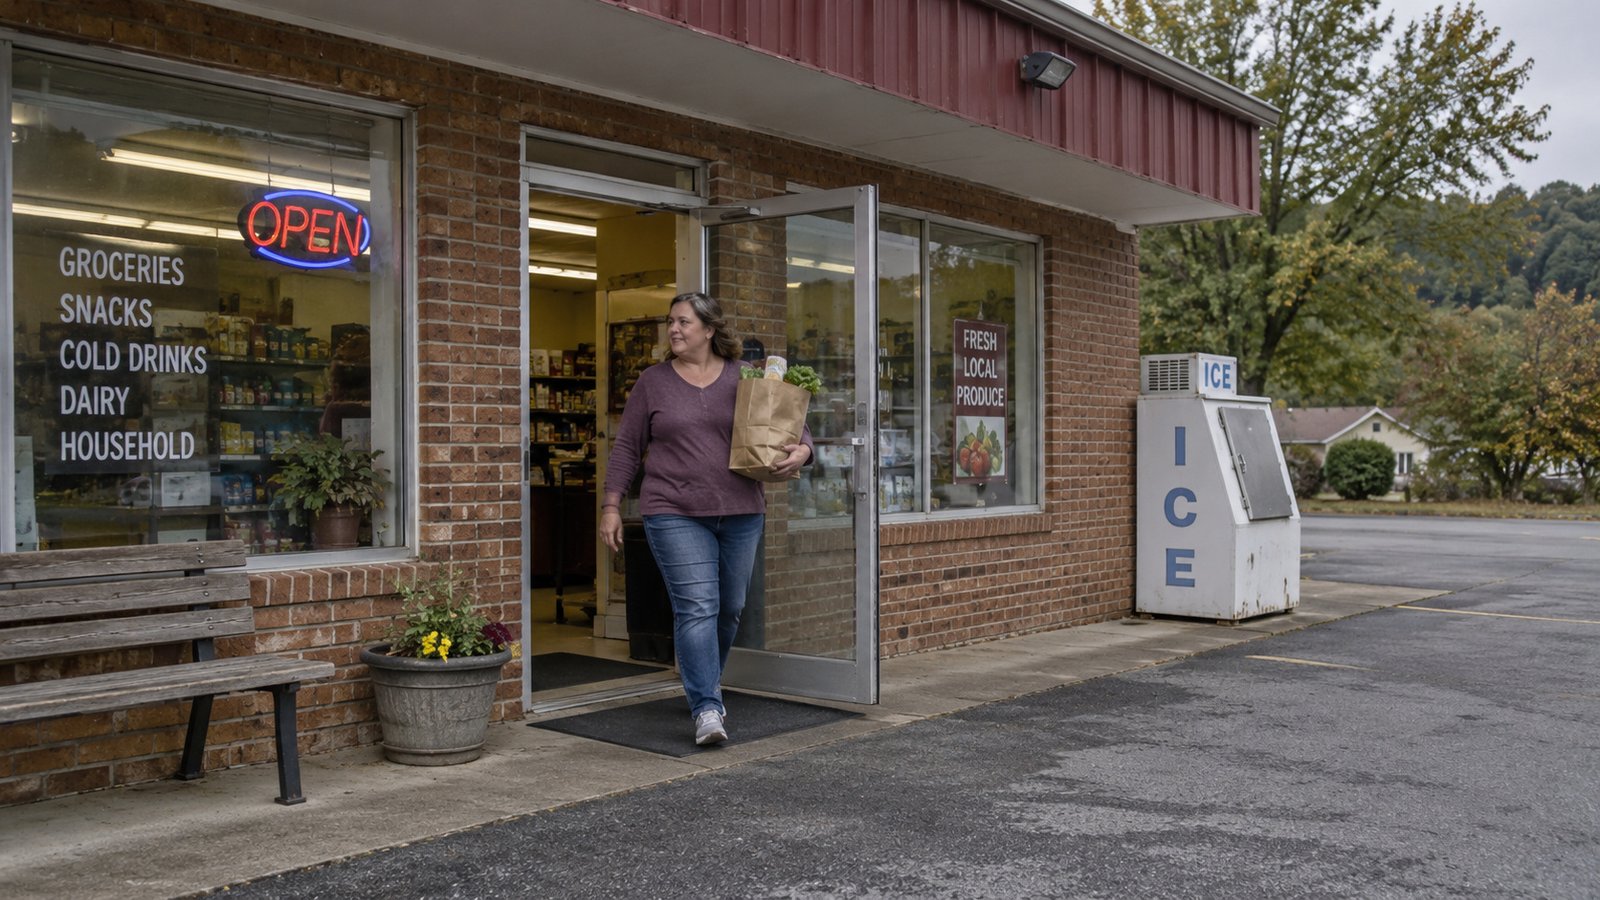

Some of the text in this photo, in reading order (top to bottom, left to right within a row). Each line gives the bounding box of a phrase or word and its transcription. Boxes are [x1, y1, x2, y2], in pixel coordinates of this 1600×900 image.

[247, 200, 364, 257] OPEN
[59, 246, 185, 286] GROCERIES
[60, 293, 153, 328] SNACKS
[963, 328, 997, 351] FRESH
[59, 340, 208, 375] COLD DRINKS
[963, 356, 998, 379] LOCAL
[1204, 362, 1231, 389] ICE
[60, 385, 130, 416] DAIRY
[956, 385, 1005, 407] PRODUCE
[60, 430, 195, 461] HOUSEHOLD
[1163, 426, 1198, 588] ICE
